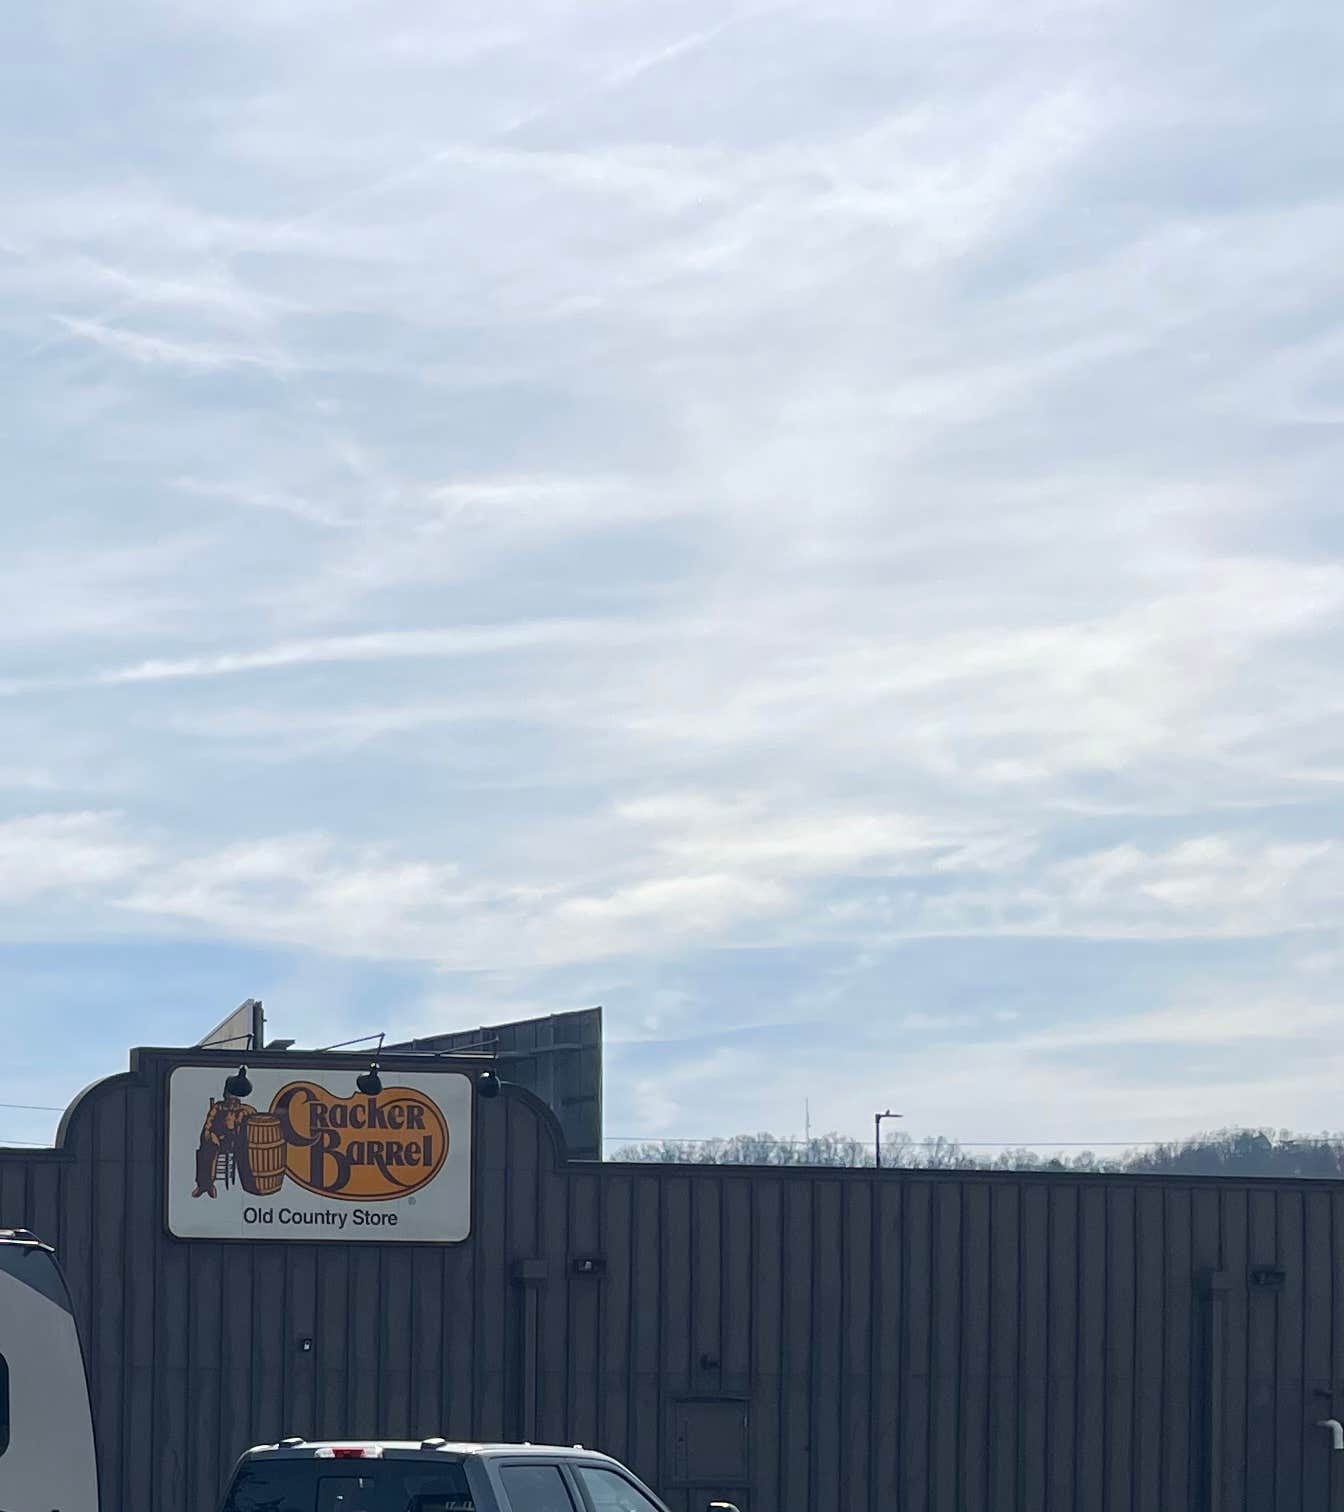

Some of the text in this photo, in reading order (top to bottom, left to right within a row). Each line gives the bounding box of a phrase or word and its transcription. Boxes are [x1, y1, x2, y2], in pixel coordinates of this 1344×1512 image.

[276, 1086, 426, 1147] Cracker
[310, 1129, 433, 1192] Barrel
[243, 1207, 399, 1230] Old Country Store
